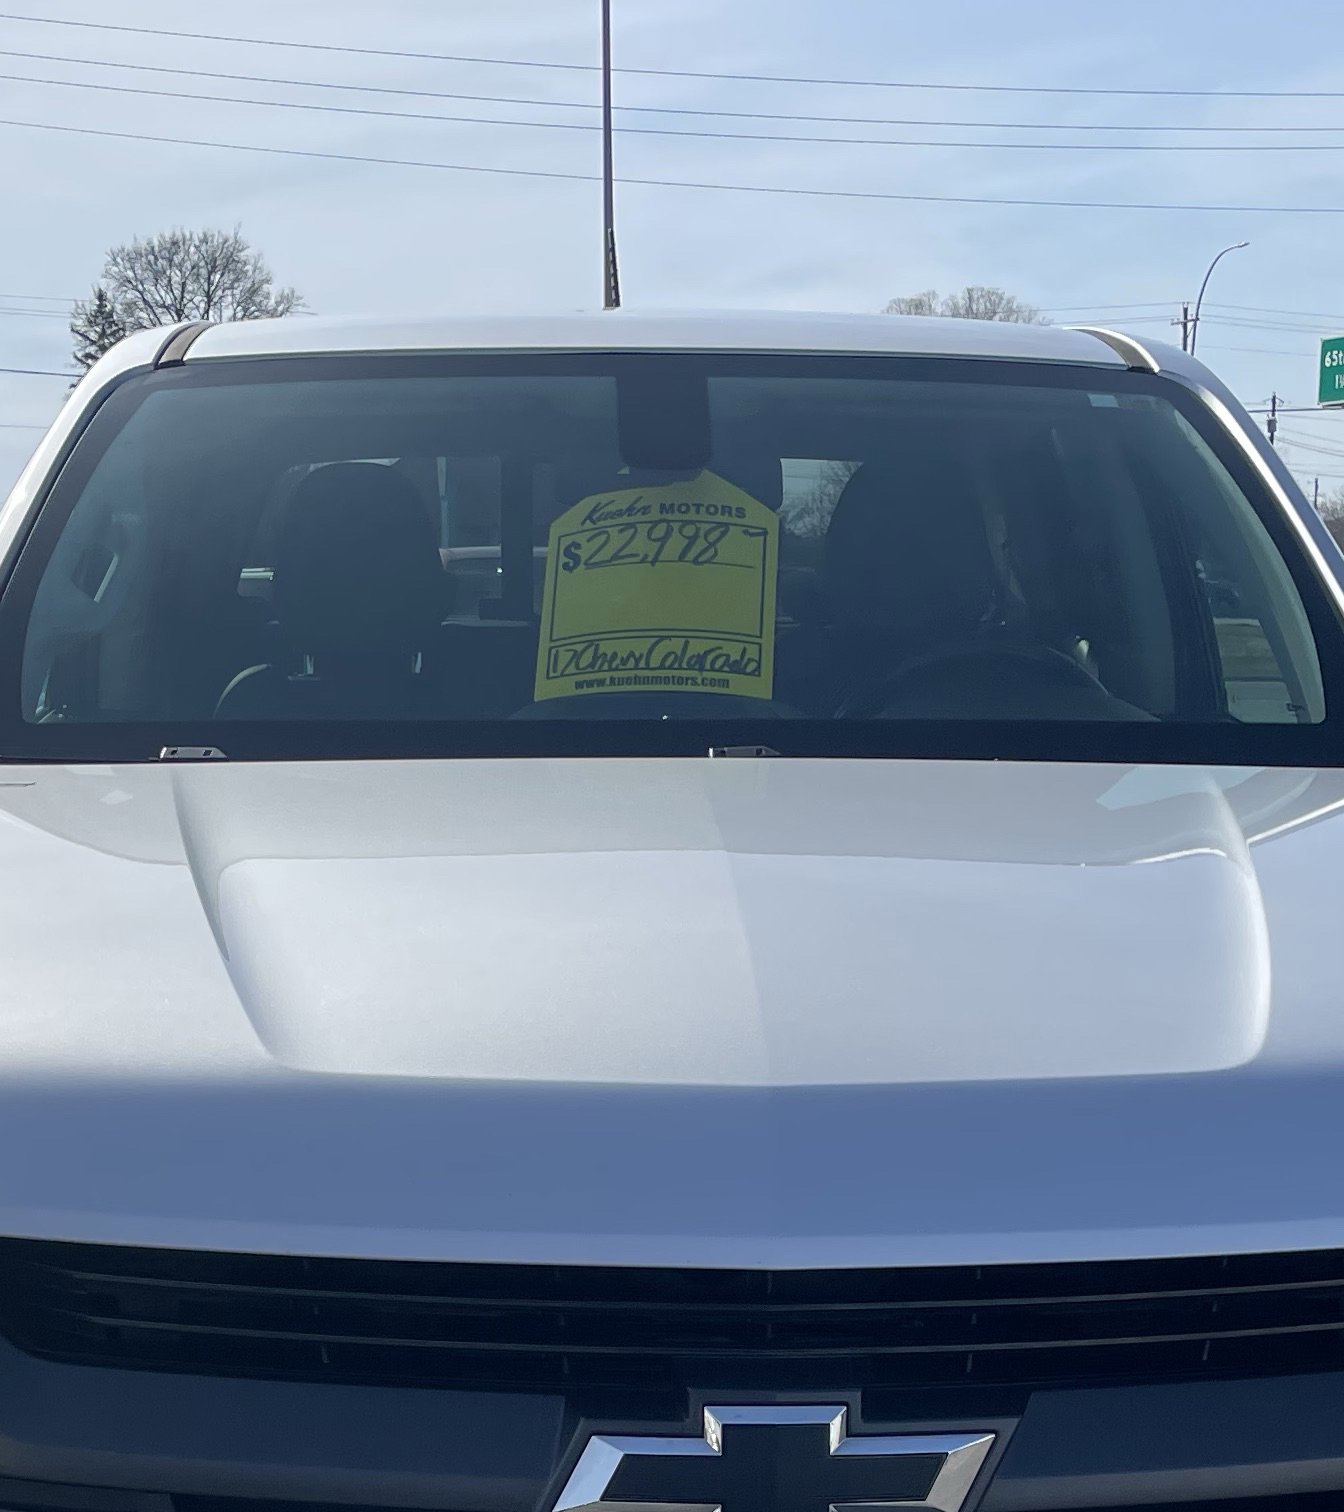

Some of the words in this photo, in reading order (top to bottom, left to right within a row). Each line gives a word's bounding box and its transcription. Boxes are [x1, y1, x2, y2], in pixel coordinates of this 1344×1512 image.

[581, 496, 652, 526] Kuehn
[658, 502, 747, 519] MOTORS
[574, 674, 730, 690] www.kuehnmotors.com
